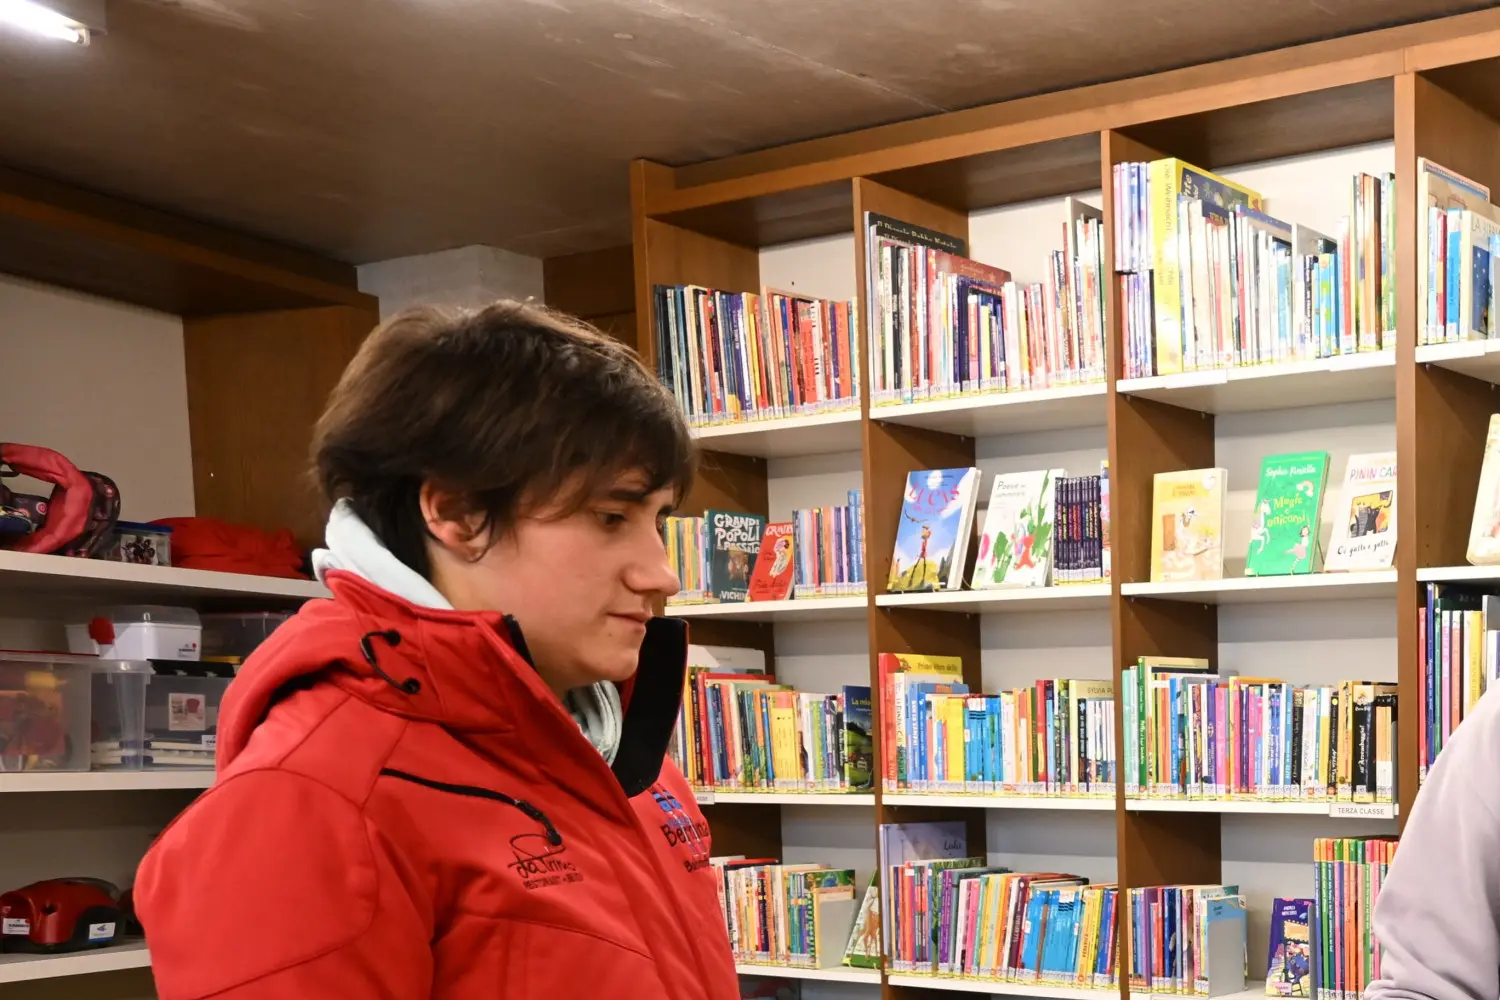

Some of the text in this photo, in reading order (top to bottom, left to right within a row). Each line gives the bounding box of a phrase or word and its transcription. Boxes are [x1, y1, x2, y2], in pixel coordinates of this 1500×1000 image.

[1350, 465, 1378, 480] PININ
[714, 513, 760, 531] GRANDI
[715, 525, 760, 549] POPOLI
[1338, 806, 1385, 815] TERZA CLASSE
